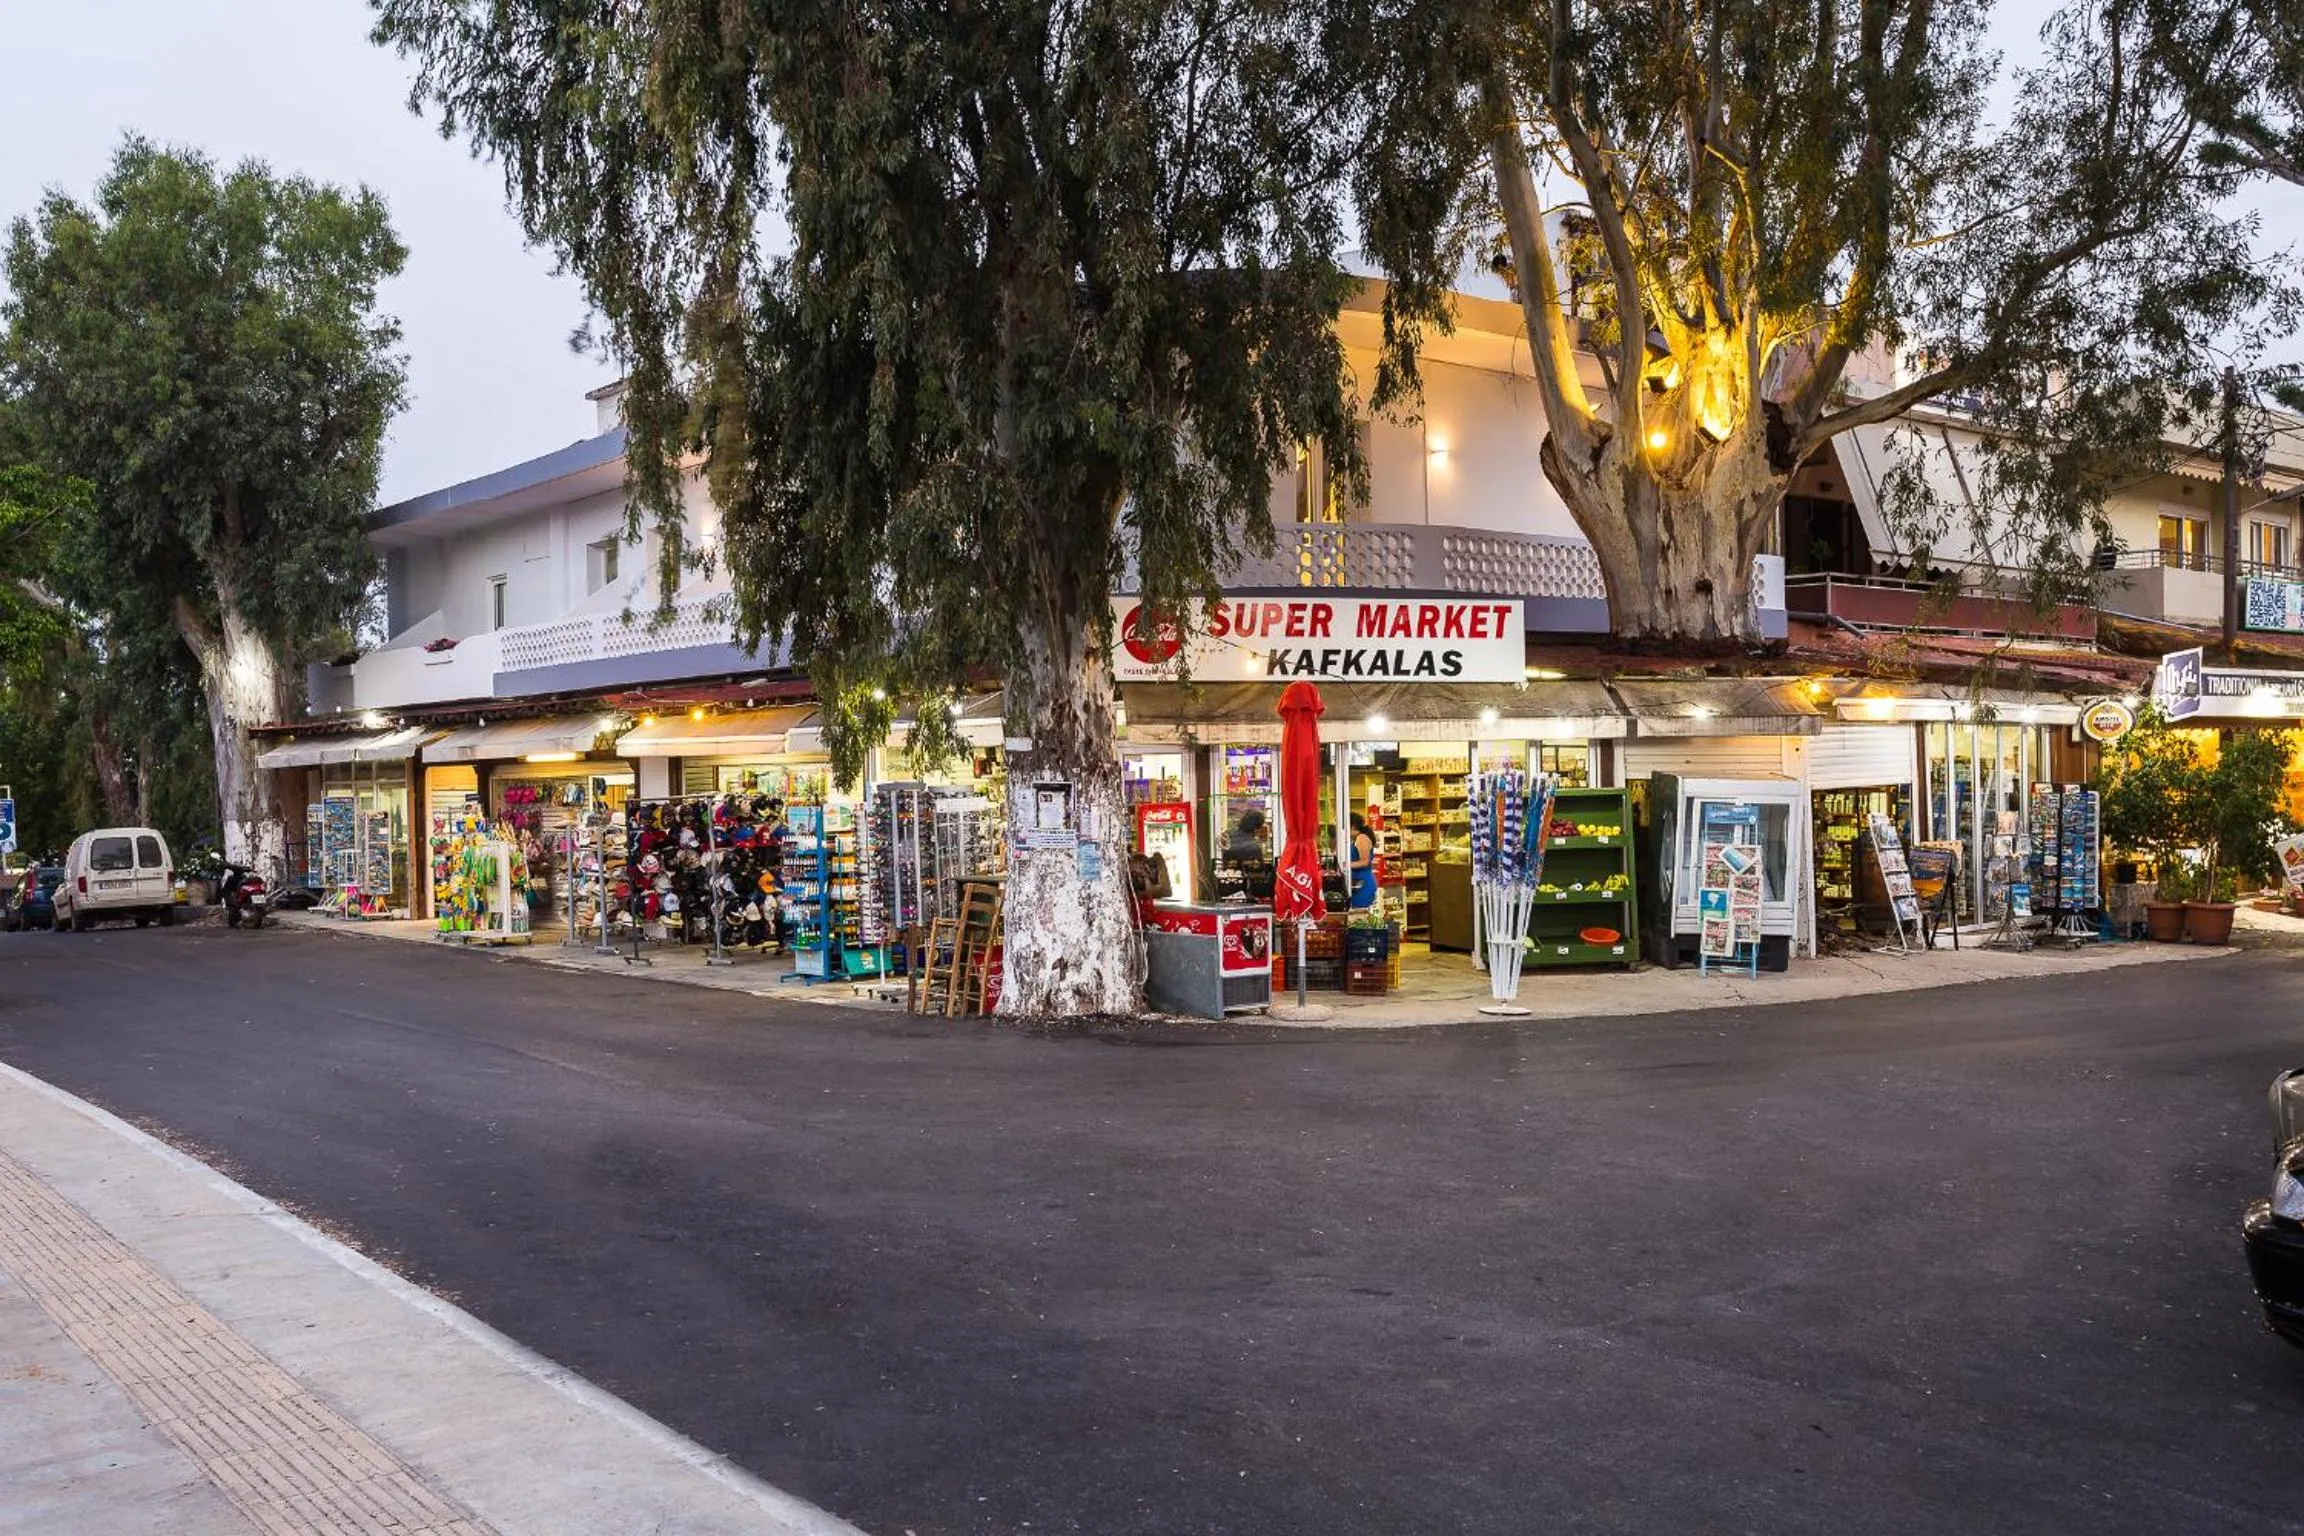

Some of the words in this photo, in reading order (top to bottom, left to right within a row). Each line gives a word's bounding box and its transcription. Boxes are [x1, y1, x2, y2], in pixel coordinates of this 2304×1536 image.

[1207, 603, 1334, 639] SUPER
[1356, 604, 1512, 640] MARKET
[1266, 649, 1464, 677] KAFKALAS
